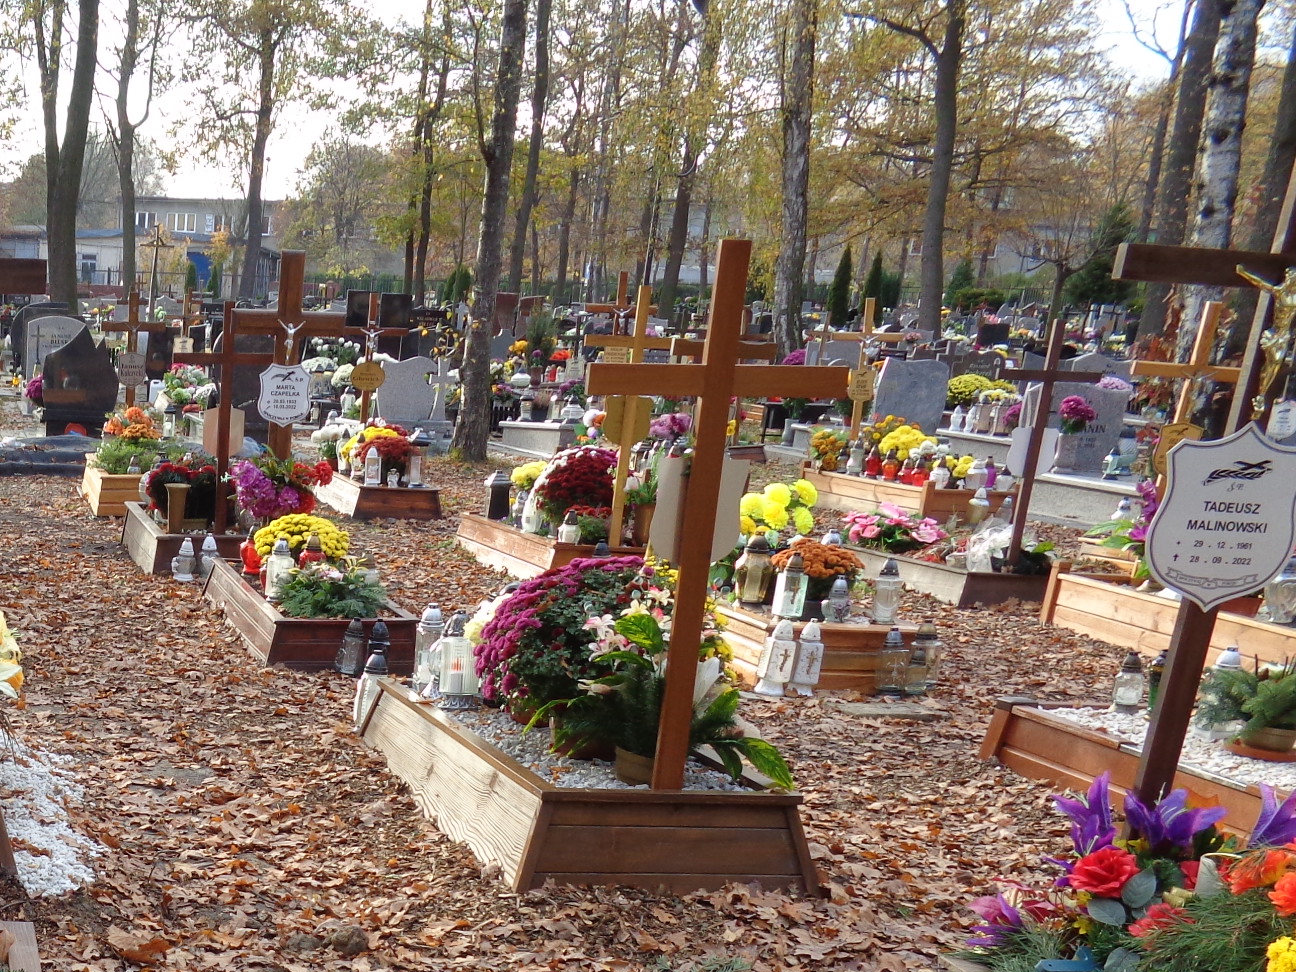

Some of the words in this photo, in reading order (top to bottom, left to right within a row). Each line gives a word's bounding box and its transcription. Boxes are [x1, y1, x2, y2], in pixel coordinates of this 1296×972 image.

[1204, 500, 1261, 515] TADEUSZ
[1186, 519, 1268, 534] MALINOWSKI
[1193, 540, 1204, 548] 29
[1217, 541, 1225, 549] 12
[1236, 542, 1253, 551] 1961
[1189, 555, 1200, 563] 28
[1212, 556, 1222, 564] 09
[1232, 557, 1252, 565] 2022
